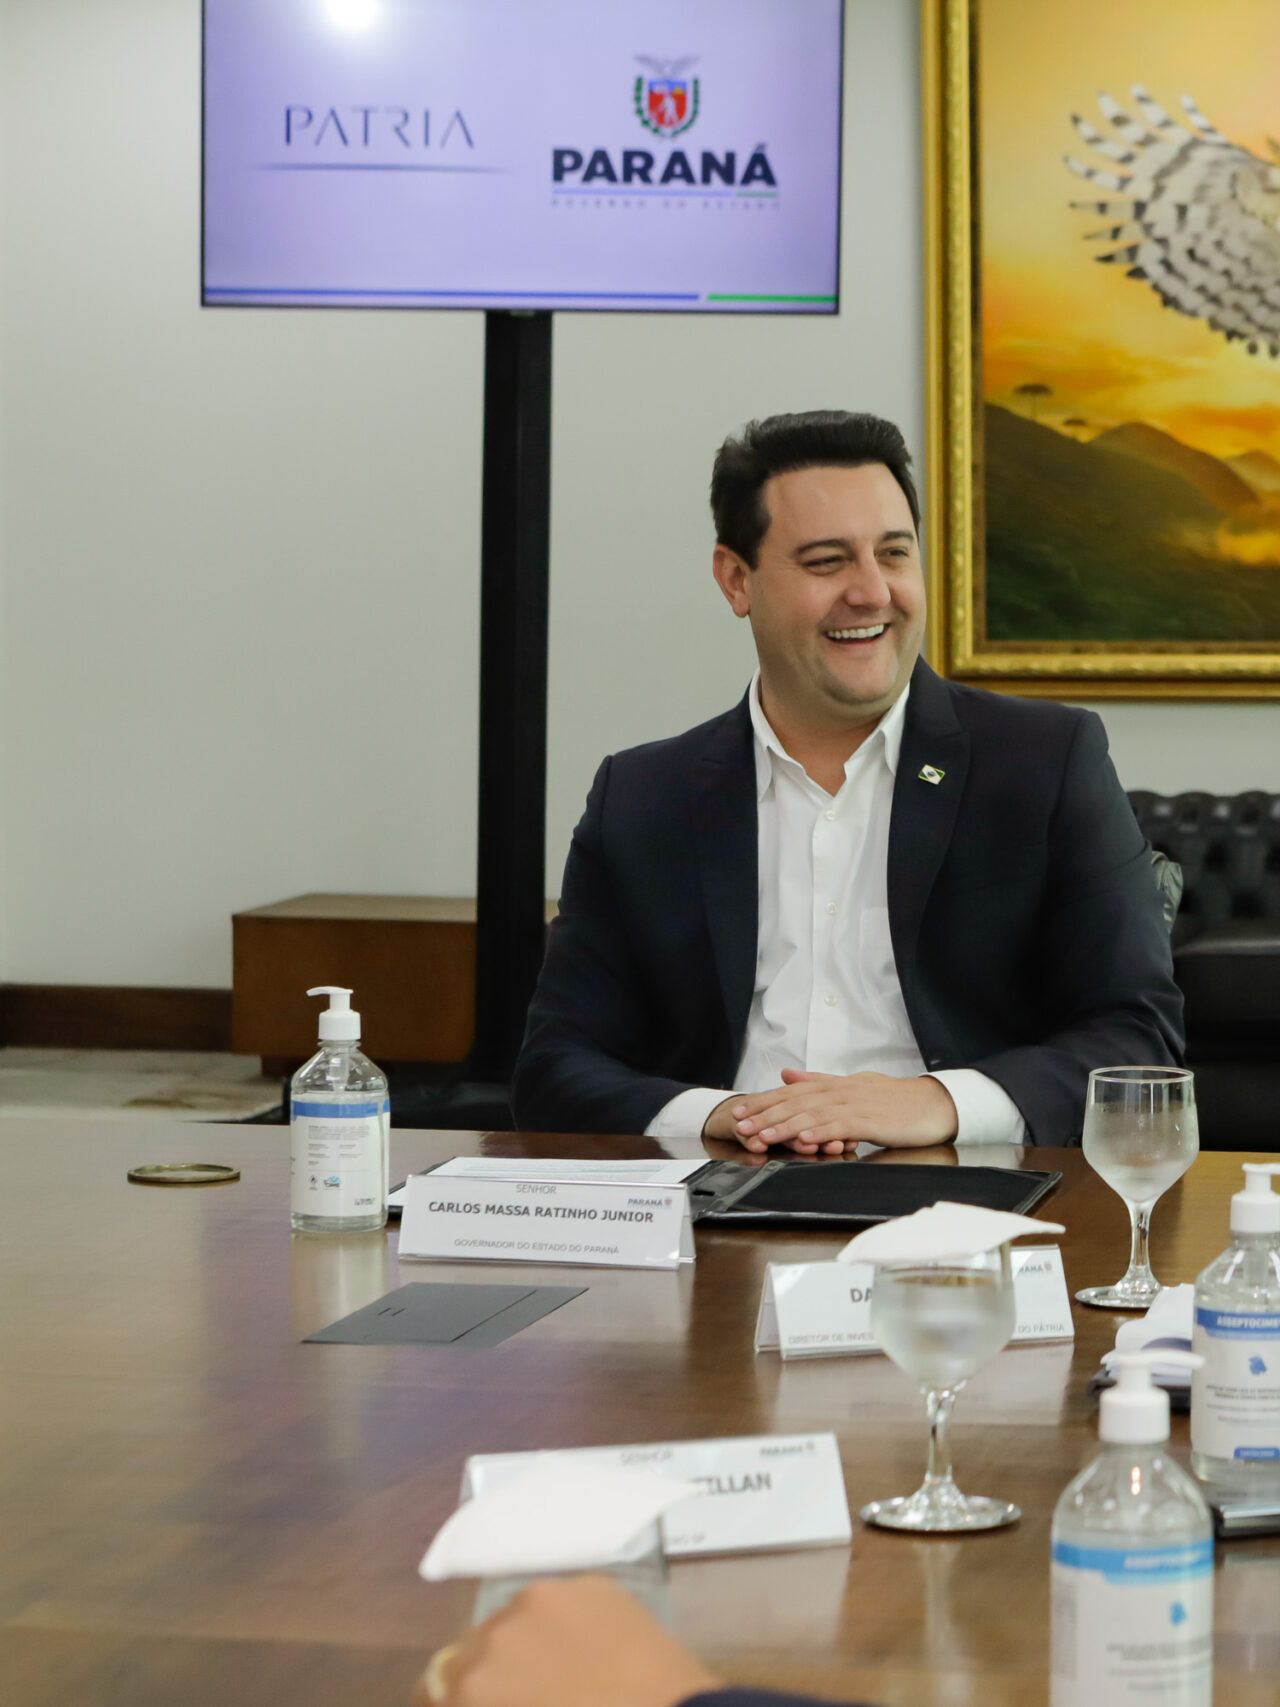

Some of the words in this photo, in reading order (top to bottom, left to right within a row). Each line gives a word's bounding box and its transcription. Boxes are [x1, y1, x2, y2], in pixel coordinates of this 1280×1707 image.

[284, 105, 475, 149] PATRIA
[552, 144, 778, 187] PARANÁ
[515, 1184, 557, 1195] SENHOR
[428, 1201, 481, 1215] CARLOS
[485, 1204, 530, 1217] MASSA
[534, 1207, 598, 1220] RATINHO
[601, 1210, 654, 1223] JUNIOR
[454, 1238, 516, 1250] GOVERNADOR
[517, 1241, 531, 1250] DO
[532, 1243, 567, 1253] ESTADO
[568, 1246, 582, 1254] DO
